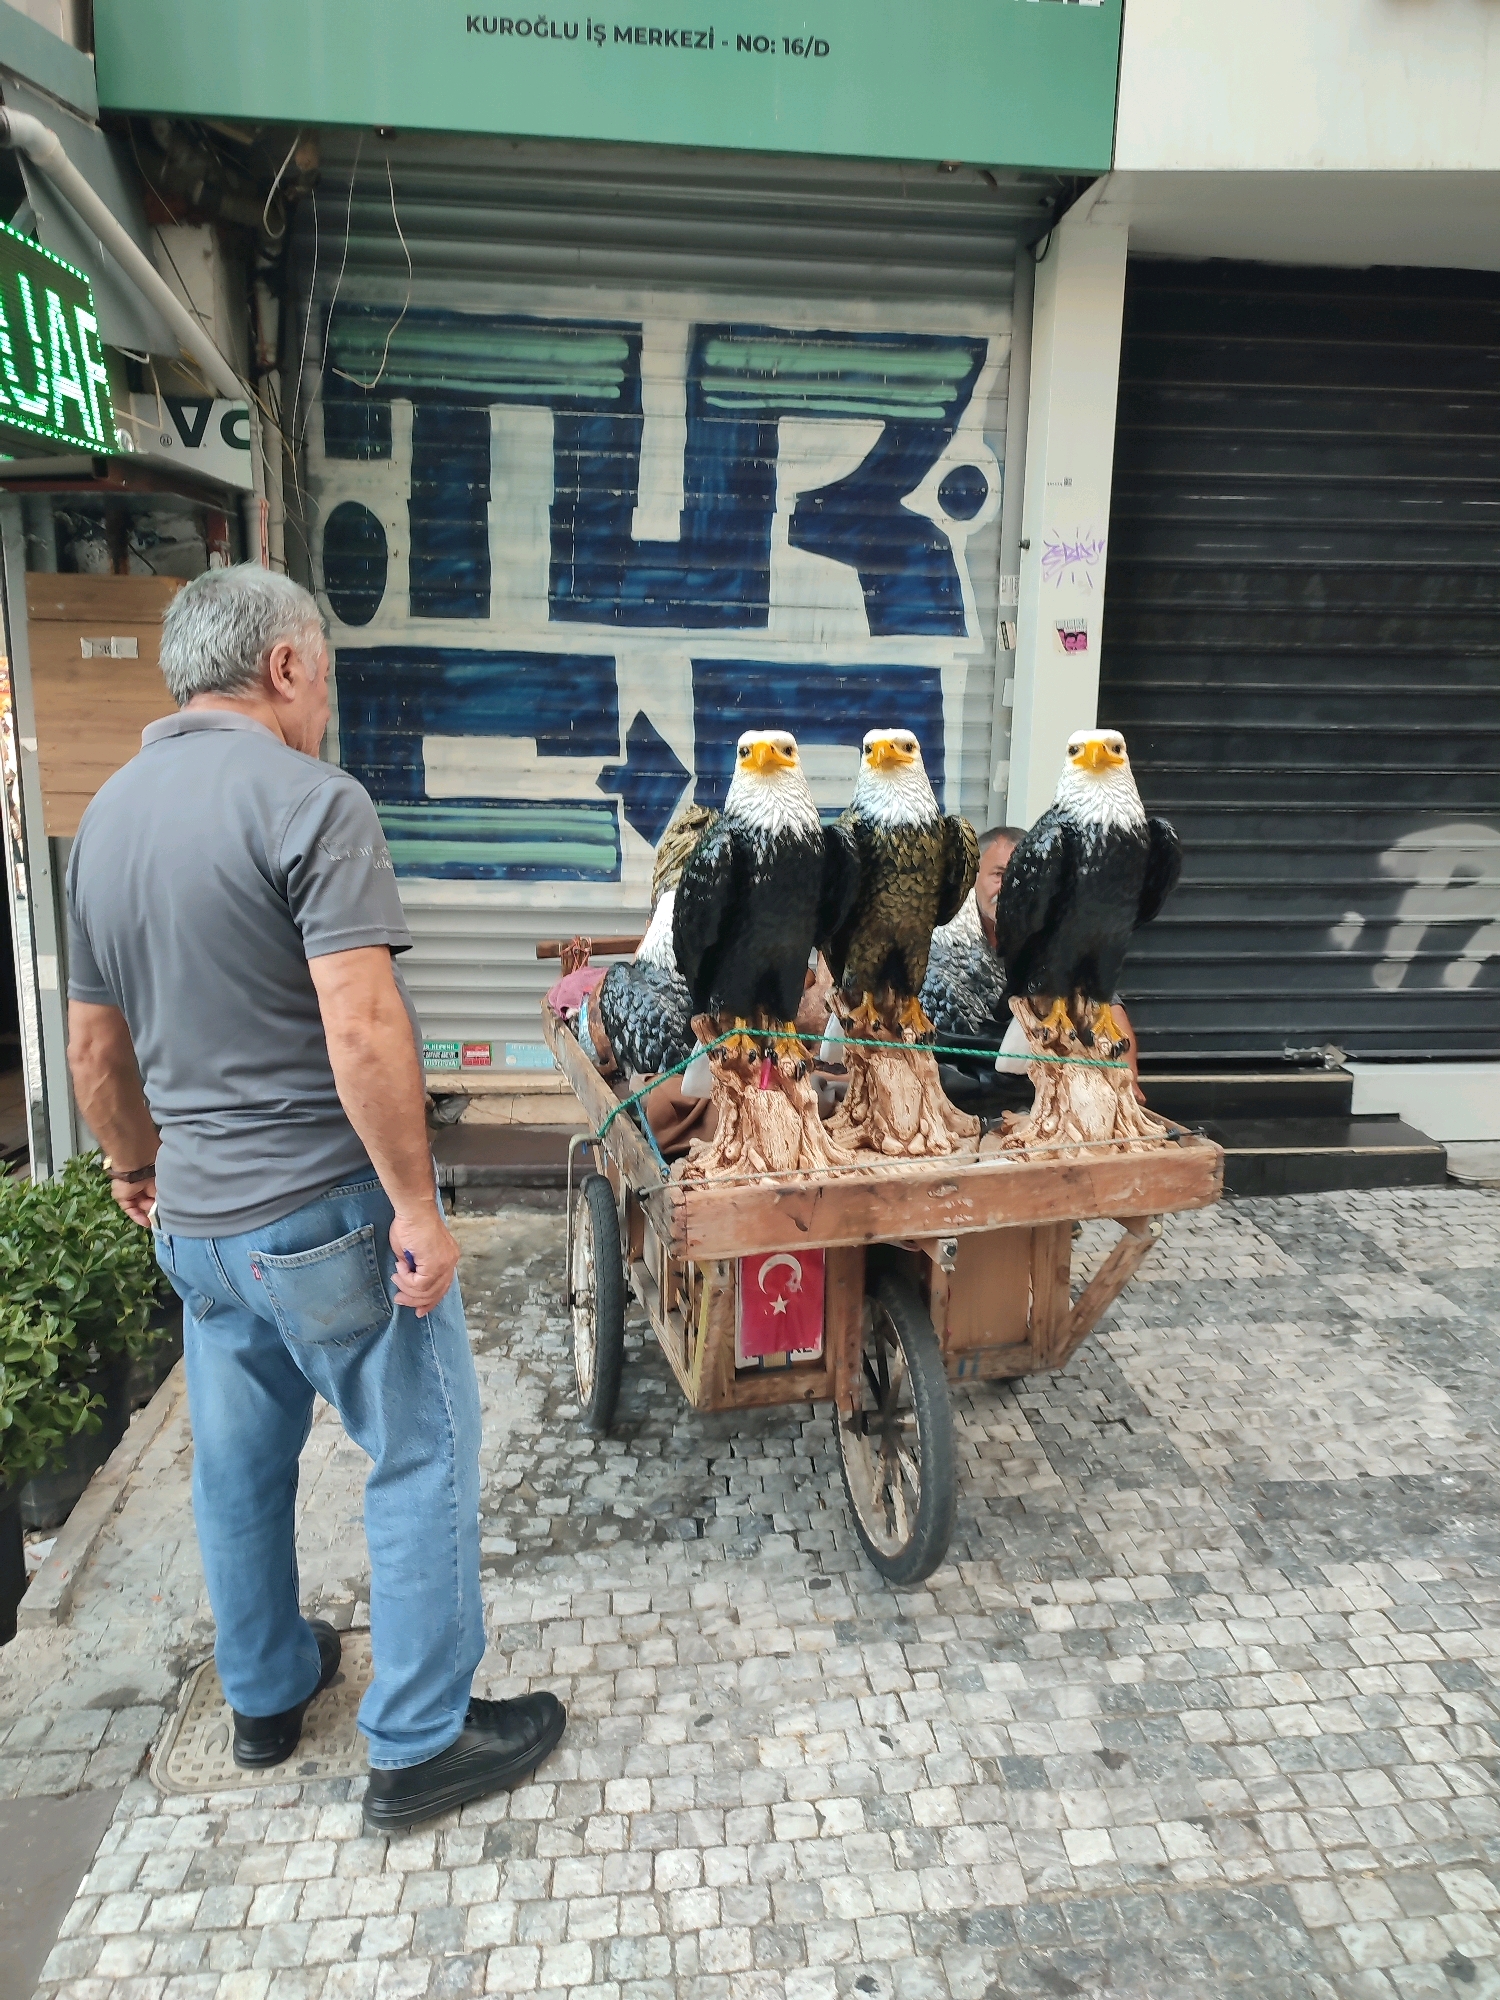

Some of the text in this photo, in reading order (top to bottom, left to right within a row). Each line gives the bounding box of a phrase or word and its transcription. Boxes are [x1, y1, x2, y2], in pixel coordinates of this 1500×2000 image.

[466, 14, 579, 40] KUROĞLU
[586, 17, 607, 48] İŞ
[613, 25, 715, 51] MERKEZİ
[736, 34, 776, 54] NO:
[783, 36, 831, 58] 16/D
